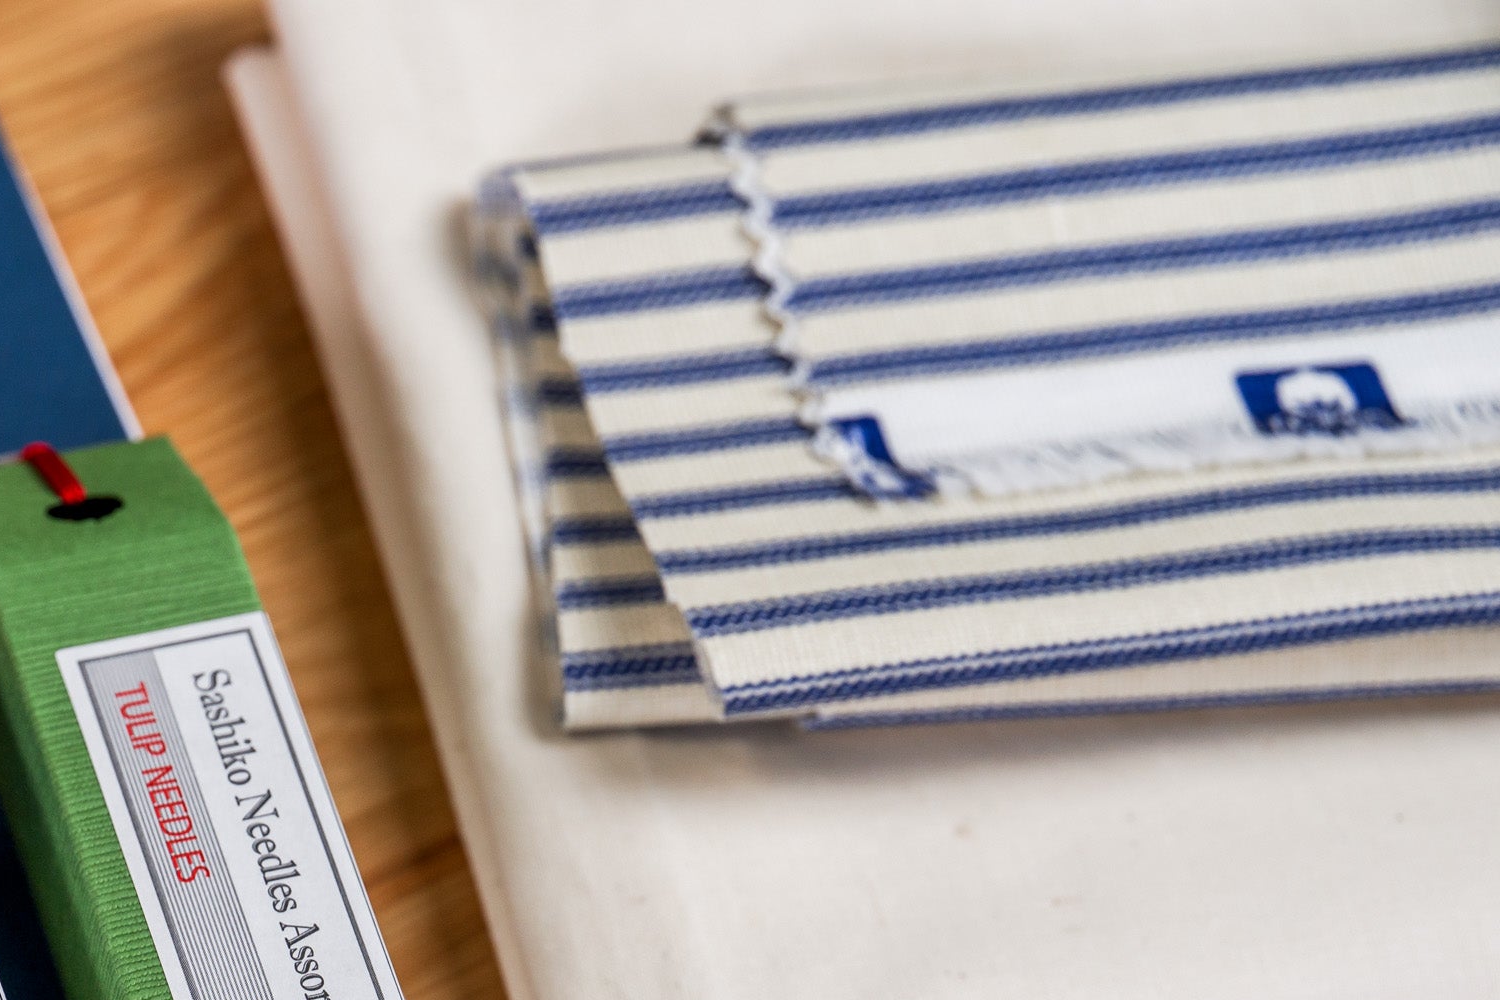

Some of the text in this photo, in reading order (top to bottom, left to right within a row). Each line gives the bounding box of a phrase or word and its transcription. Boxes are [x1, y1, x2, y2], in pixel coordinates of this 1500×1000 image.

[115, 682, 210, 883] TULIP NEEDLES
[193, 668, 258, 786] Sashiko
[235, 789, 301, 913] Needles
